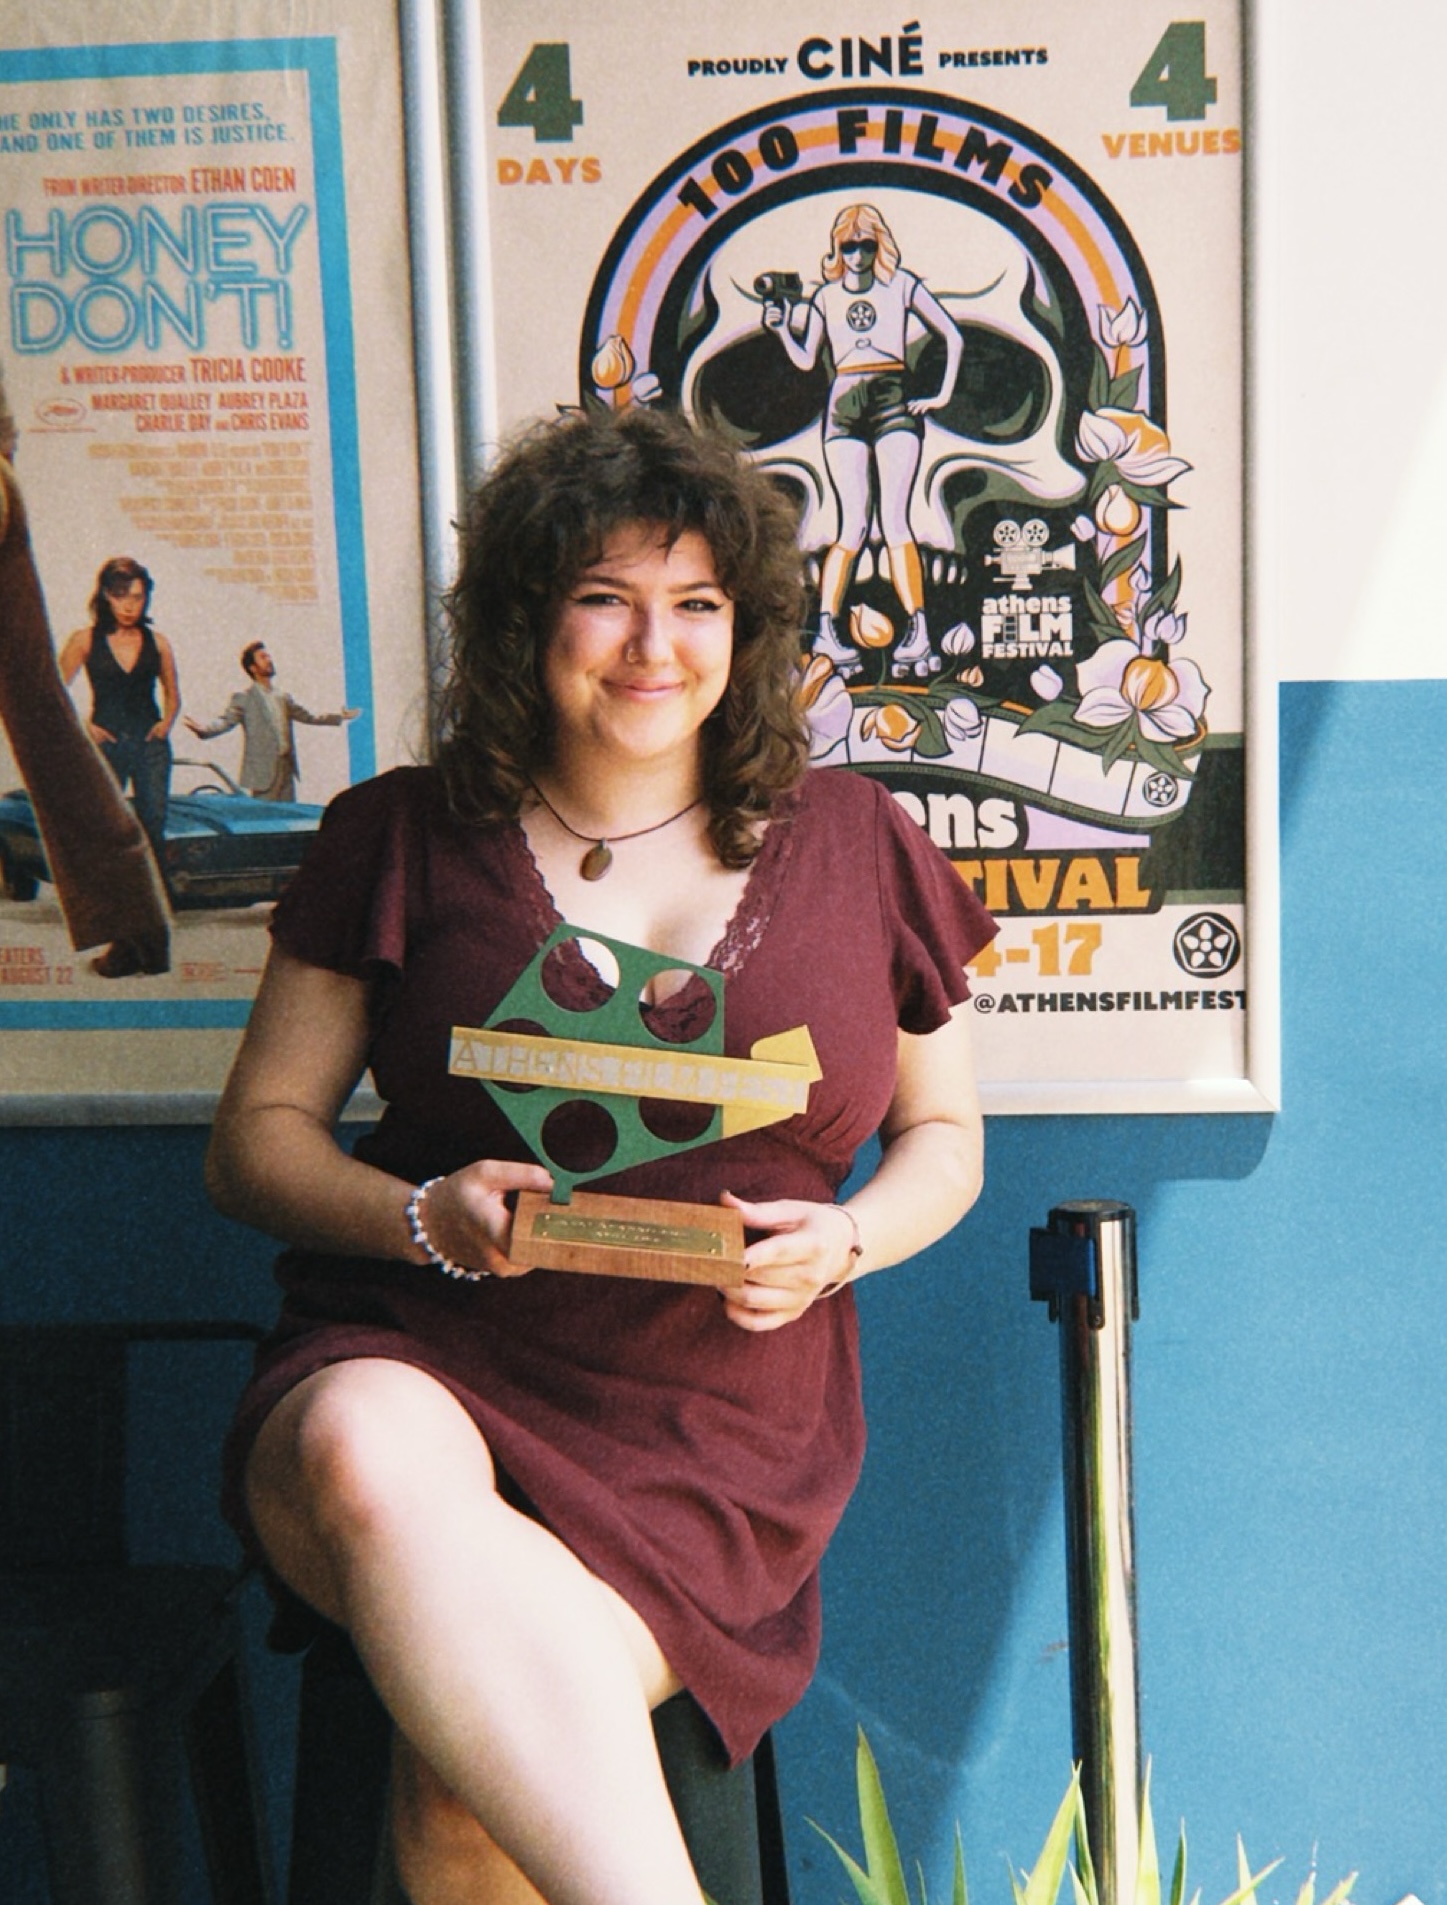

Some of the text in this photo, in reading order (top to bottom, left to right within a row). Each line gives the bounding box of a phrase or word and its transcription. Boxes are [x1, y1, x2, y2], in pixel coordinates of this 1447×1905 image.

[687, 21, 1048, 79] PROUDLY CINÉ PRESENTS
[1129, 21, 1217, 121] 4
[497, 42, 583, 142] 4
[29, 111, 77, 128] ONLY
[86, 109, 125, 126] HAS
[132, 107, 175, 124] TWO
[1, 133, 39, 152] AND
[46, 132, 84, 150] ONE
[93, 131, 116, 148] OF
[125, 128, 176, 146] THEM
[184, 127, 204, 145] IS
[1101, 129, 1242, 159] VENUES
[498, 157, 602, 185] DAYS
[677, 109, 1053, 219] 100 FILMS
[190, 168, 245, 193] ETHAN
[252, 166, 296, 192] COEN
[5, 203, 310, 278] HONEY
[10, 278, 293, 354] DON'T!
[190, 358, 246, 383] TRICIA
[252, 357, 306, 382] COOKE
[91, 394, 156, 411] MARGARET
[268, 392, 309, 410] PLAZA
[135, 414, 186, 432] CHARLIE
[189, 413, 211, 432] DAY
[230, 412, 267, 431] CHRIS
[269, 412, 309, 431] EVANS
[982, 594, 1072, 614] athens
[981, 613, 1073, 643] FILM
[982, 643, 1073, 659] FESTIVAL
[56, 965, 73, 985] 22
[973, 991, 1247, 1014] @ATHENSFILMFEST
